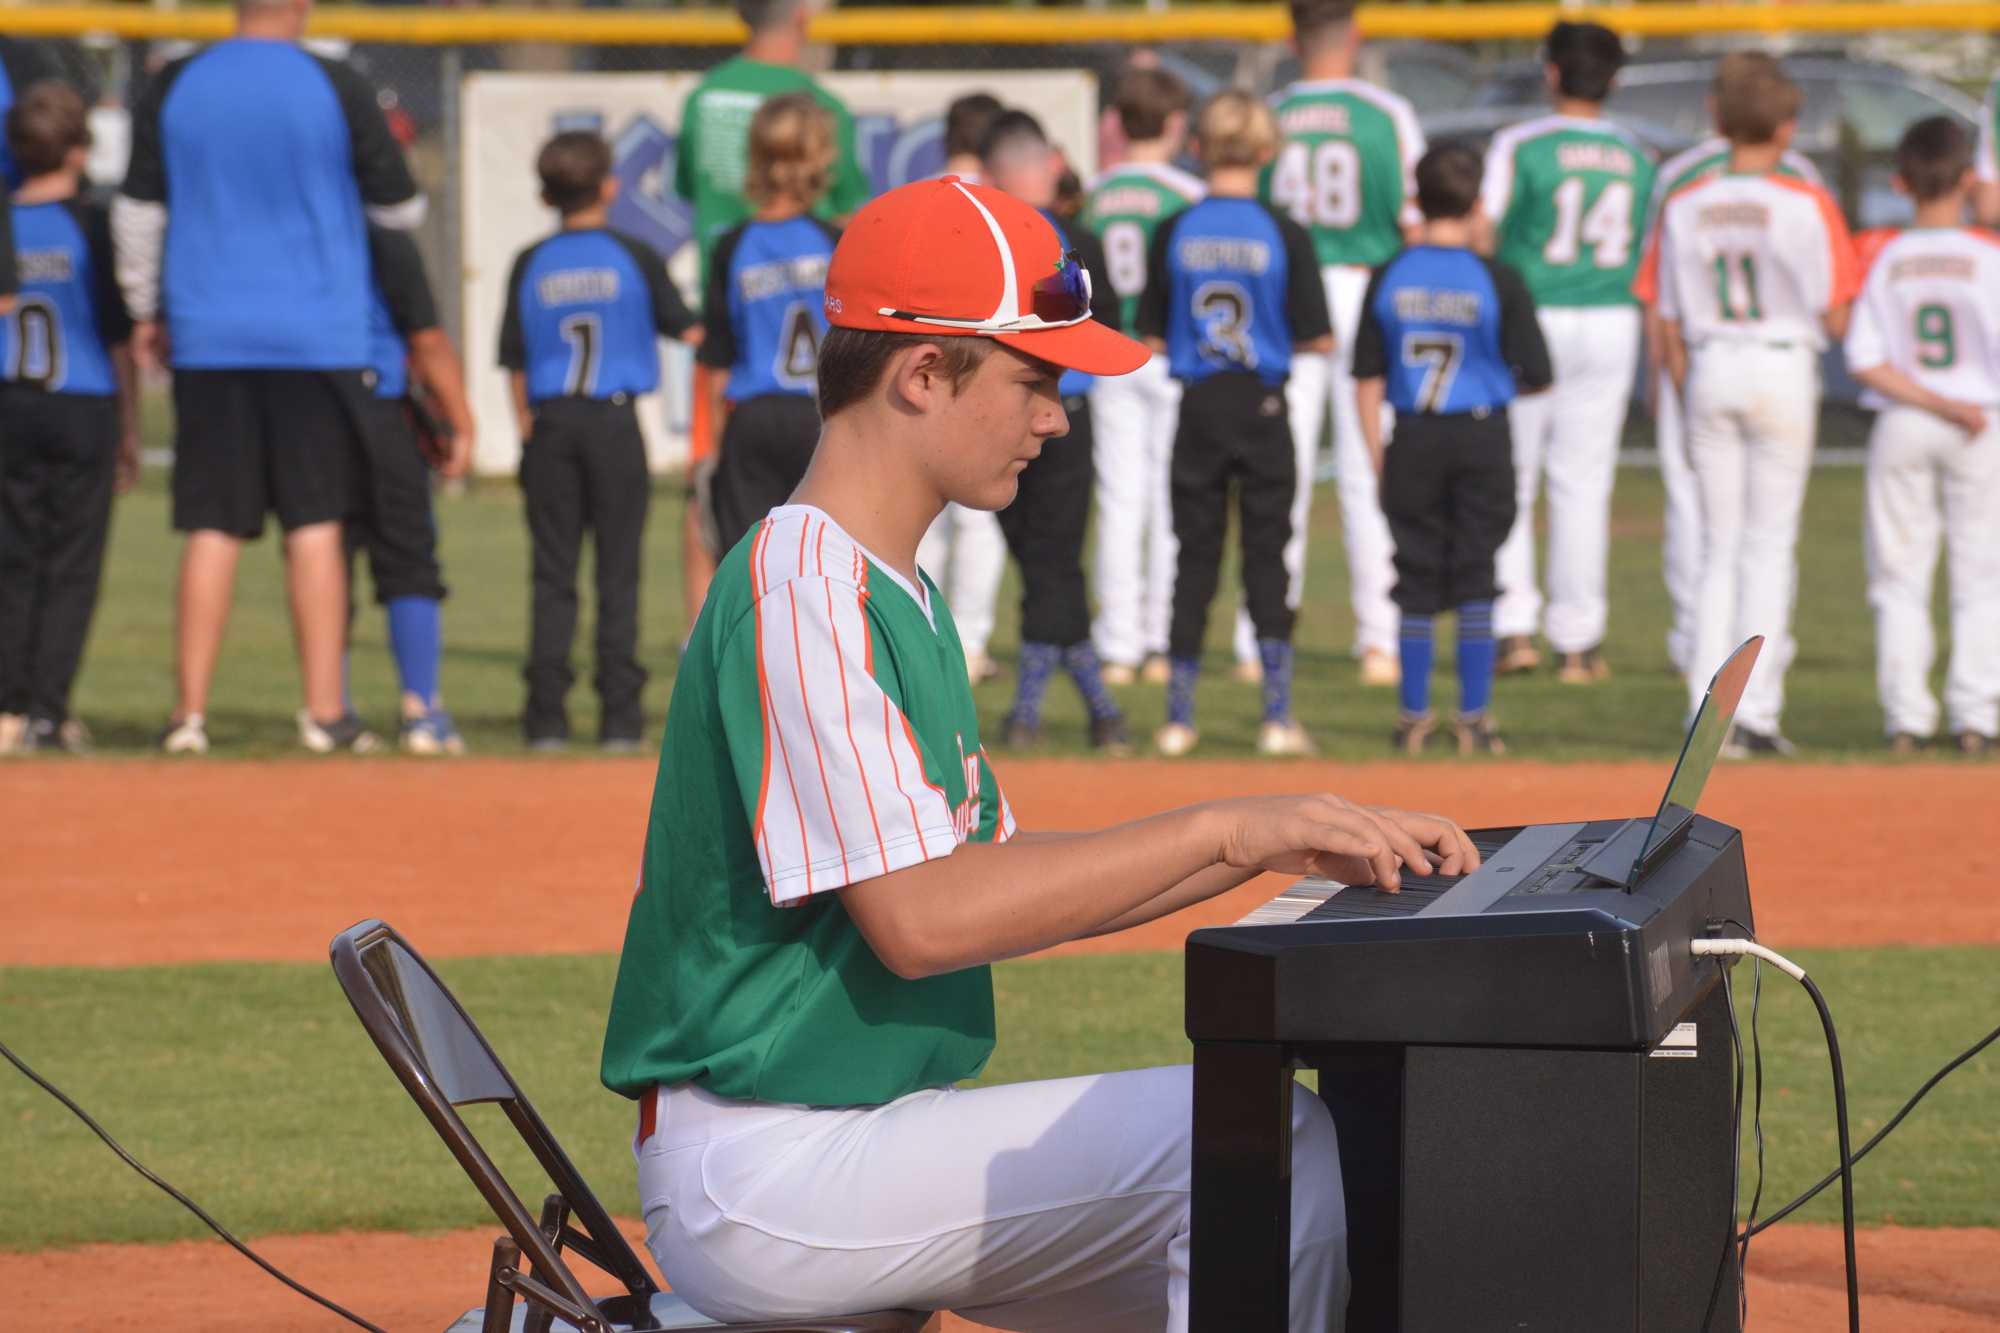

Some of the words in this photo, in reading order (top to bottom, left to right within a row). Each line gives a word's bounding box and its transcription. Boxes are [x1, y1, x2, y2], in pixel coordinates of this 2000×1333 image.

[1270, 139, 1362, 230] 48
[1543, 176, 1635, 269] 14
[1102, 221, 1148, 298] 8
[1707, 248, 1763, 321] 11
[772, 300, 819, 397] 4
[1191, 280, 1259, 371] 3
[1913, 300, 1957, 371] 9
[1401, 331, 1465, 414] 7
